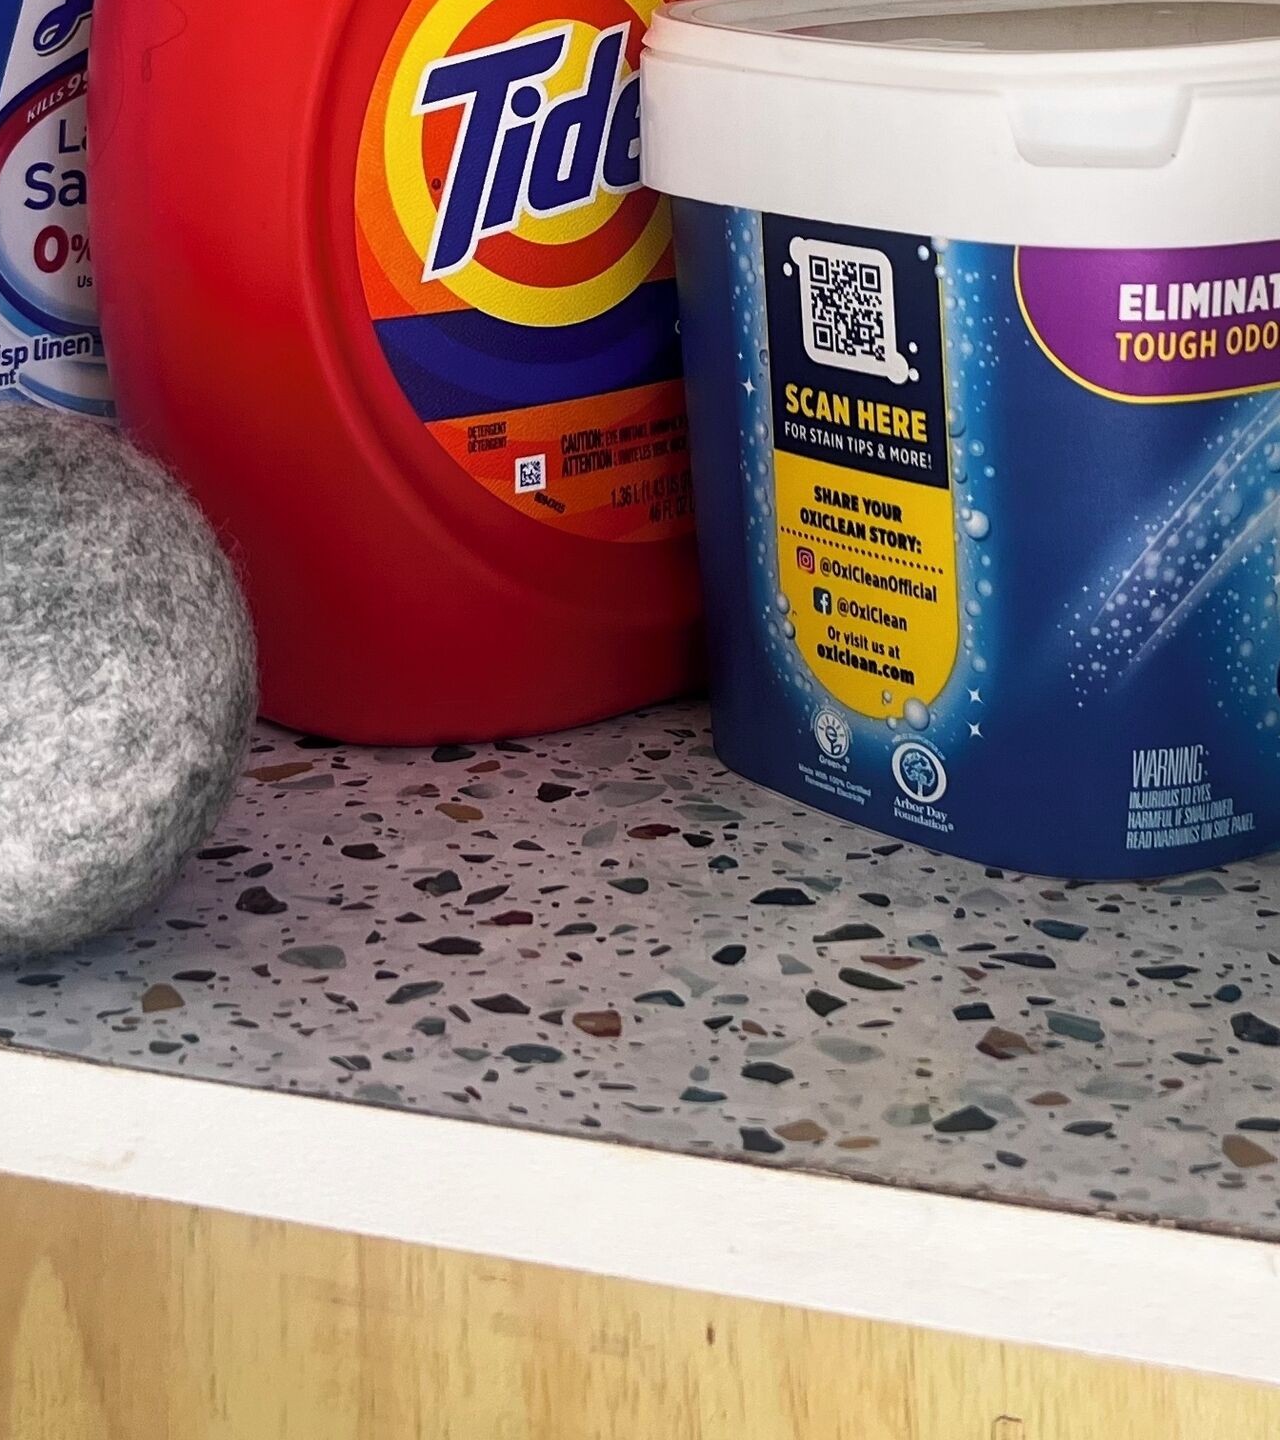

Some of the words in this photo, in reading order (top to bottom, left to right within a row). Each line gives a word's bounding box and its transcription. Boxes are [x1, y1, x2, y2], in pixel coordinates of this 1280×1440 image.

[27, 86, 65, 124] KILLS
[58, 119, 87, 154] L
[33, 334, 91, 361] linen
[1115, 329, 1217, 362] TOUGH
[785, 383, 850, 426] SCAN
[857, 400, 927, 443] HERE
[784, 421, 807, 441] FOR
[810, 427, 844, 451] STAIN
[847, 435, 874, 458] TIPS
[877, 441, 887, 460] &
[889, 445, 932, 470] MORE!
[813, 485, 859, 513] SHARE
[862, 496, 902, 523] YOUR
[800, 507, 866, 541] OXICLEAN
[869, 526, 922, 555] STORY:
[827, 625, 841, 641] Or
[843, 632, 869, 651] visit
[871, 641, 885, 656] us
[888, 644, 901, 660] at
[816, 642, 915, 686] oxiclean.com
[1132, 744, 1210, 788] WARNING:
[893, 795, 925, 813] Arbor
[926, 802, 949, 822] Day
[1127, 808, 1173, 830] HARMFUL
[1125, 830, 1153, 850] READ
